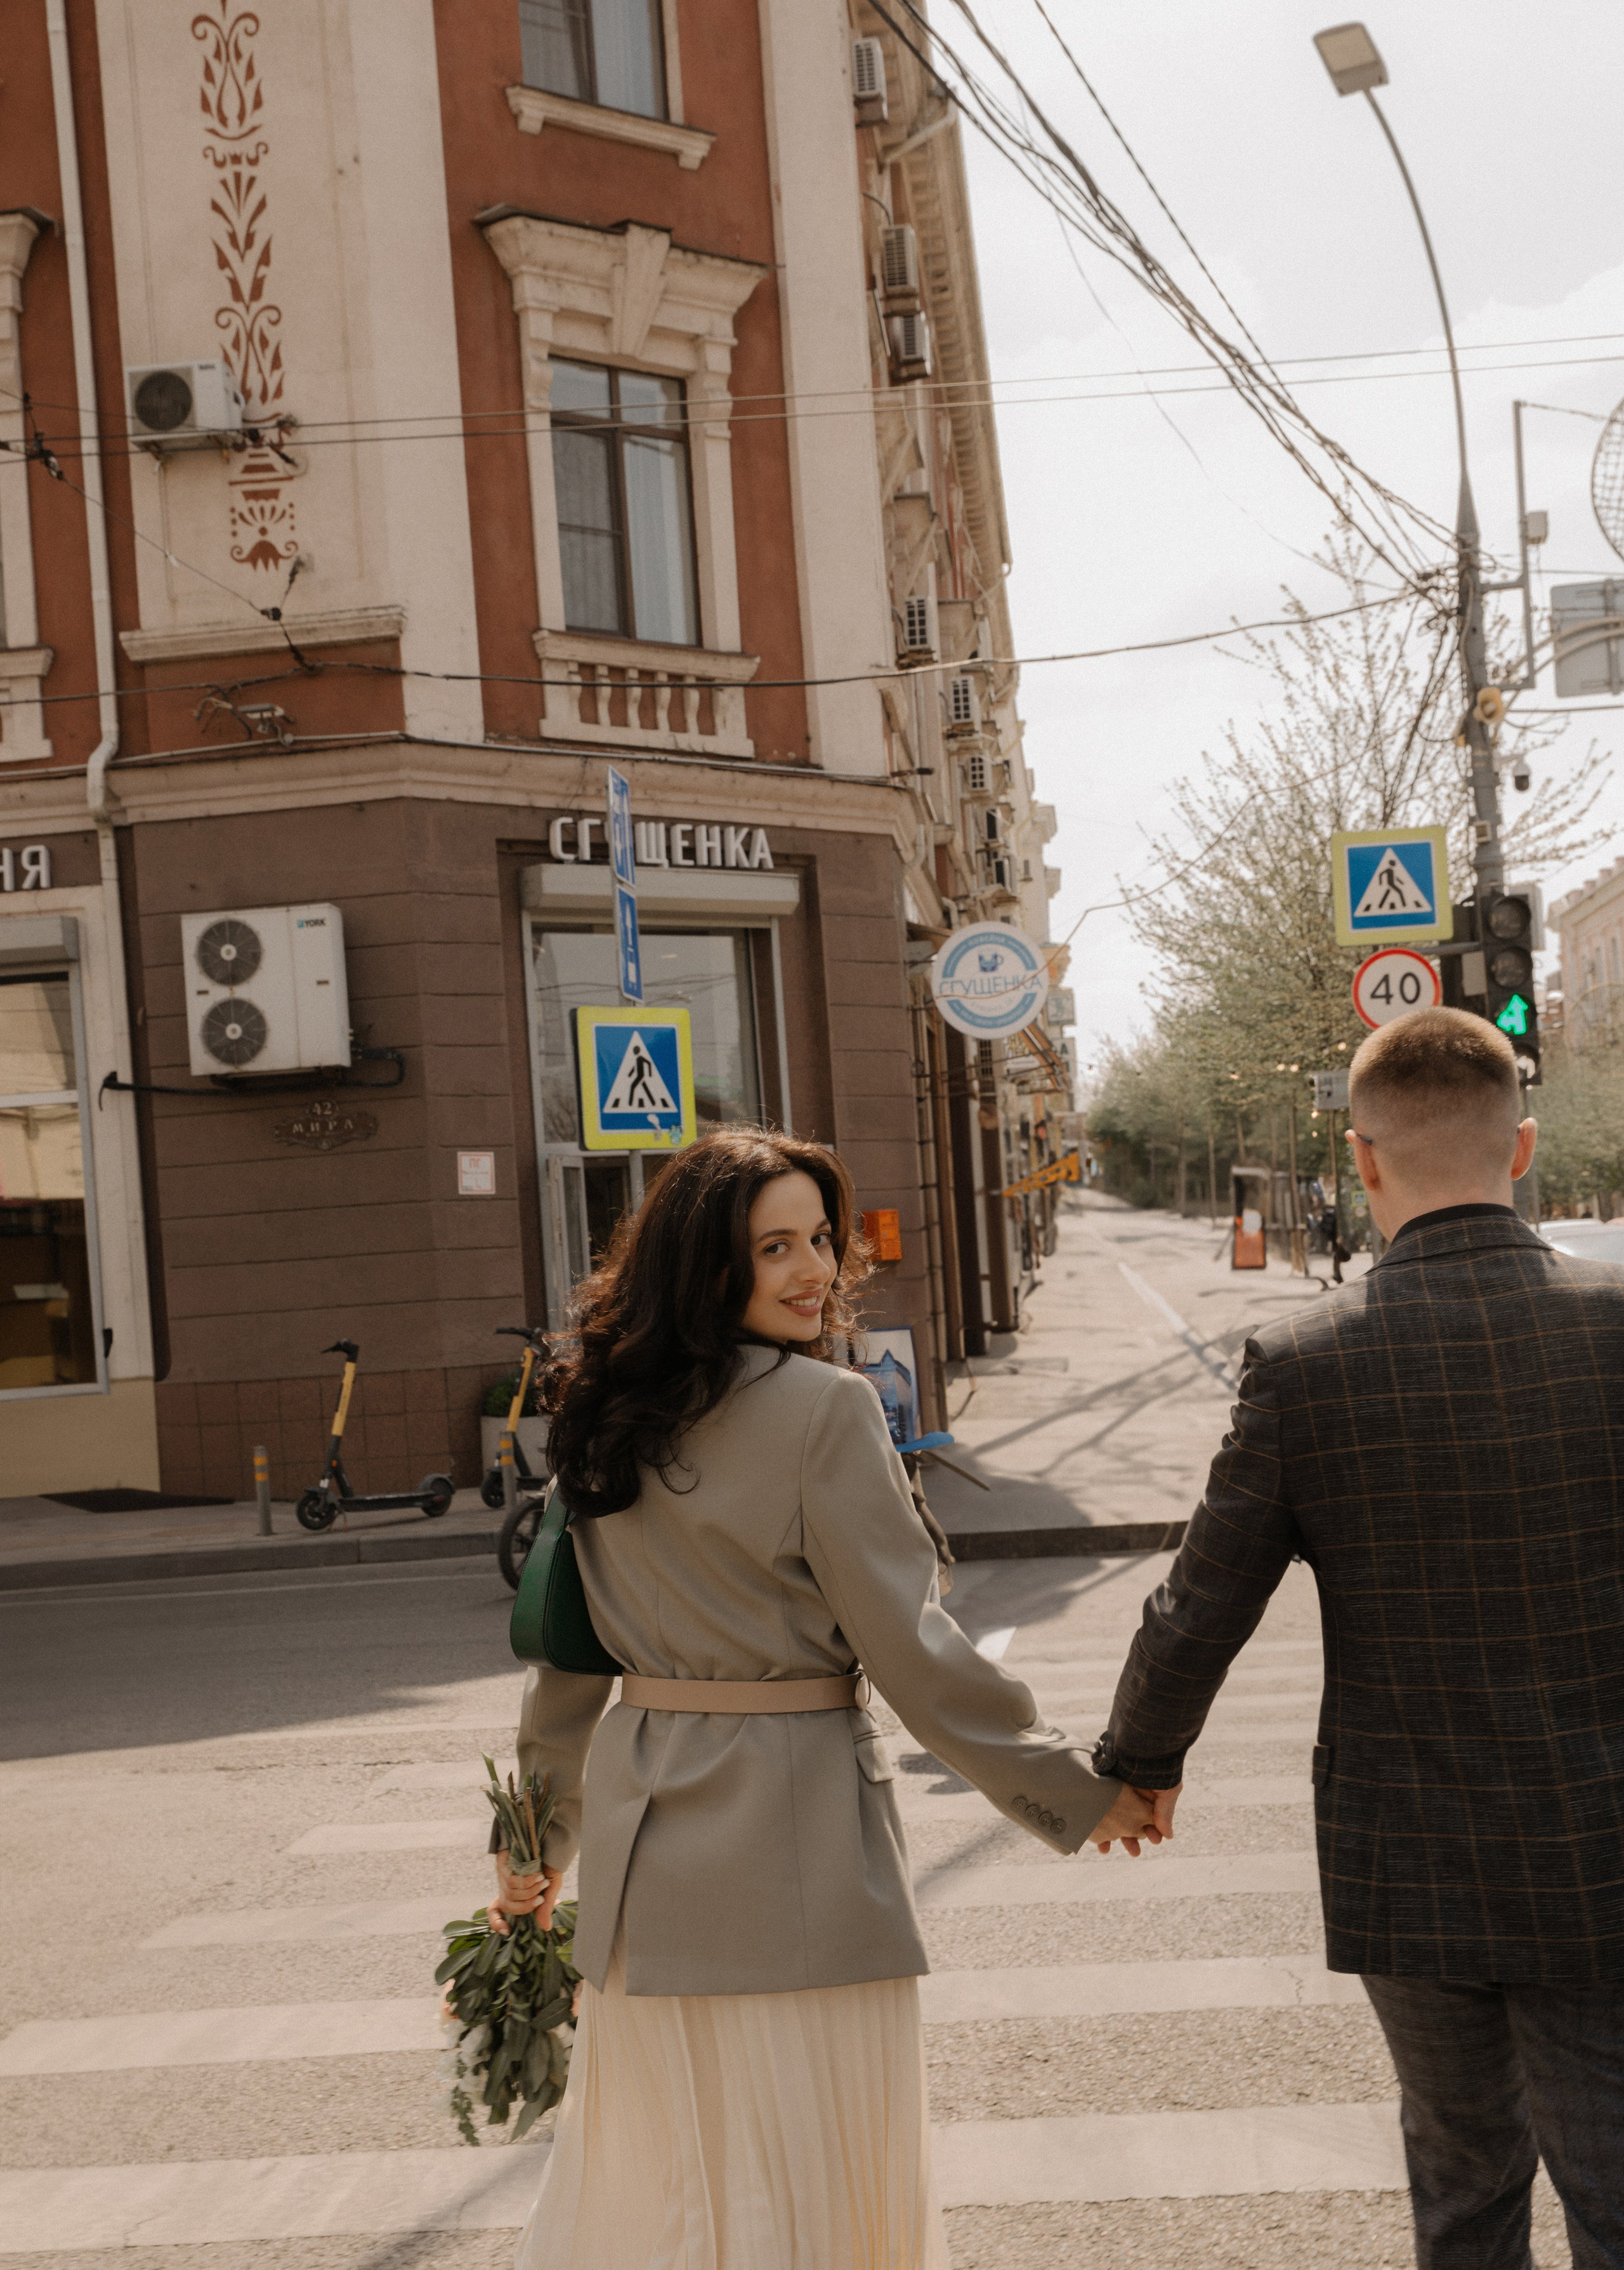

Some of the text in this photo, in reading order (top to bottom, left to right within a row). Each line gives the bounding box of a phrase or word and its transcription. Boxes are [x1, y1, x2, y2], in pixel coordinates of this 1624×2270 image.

[549, 817, 775, 870] СГЩЕНКА
[1371, 973, 1420, 1004] 40
[312, 1101, 332, 1115] 42
